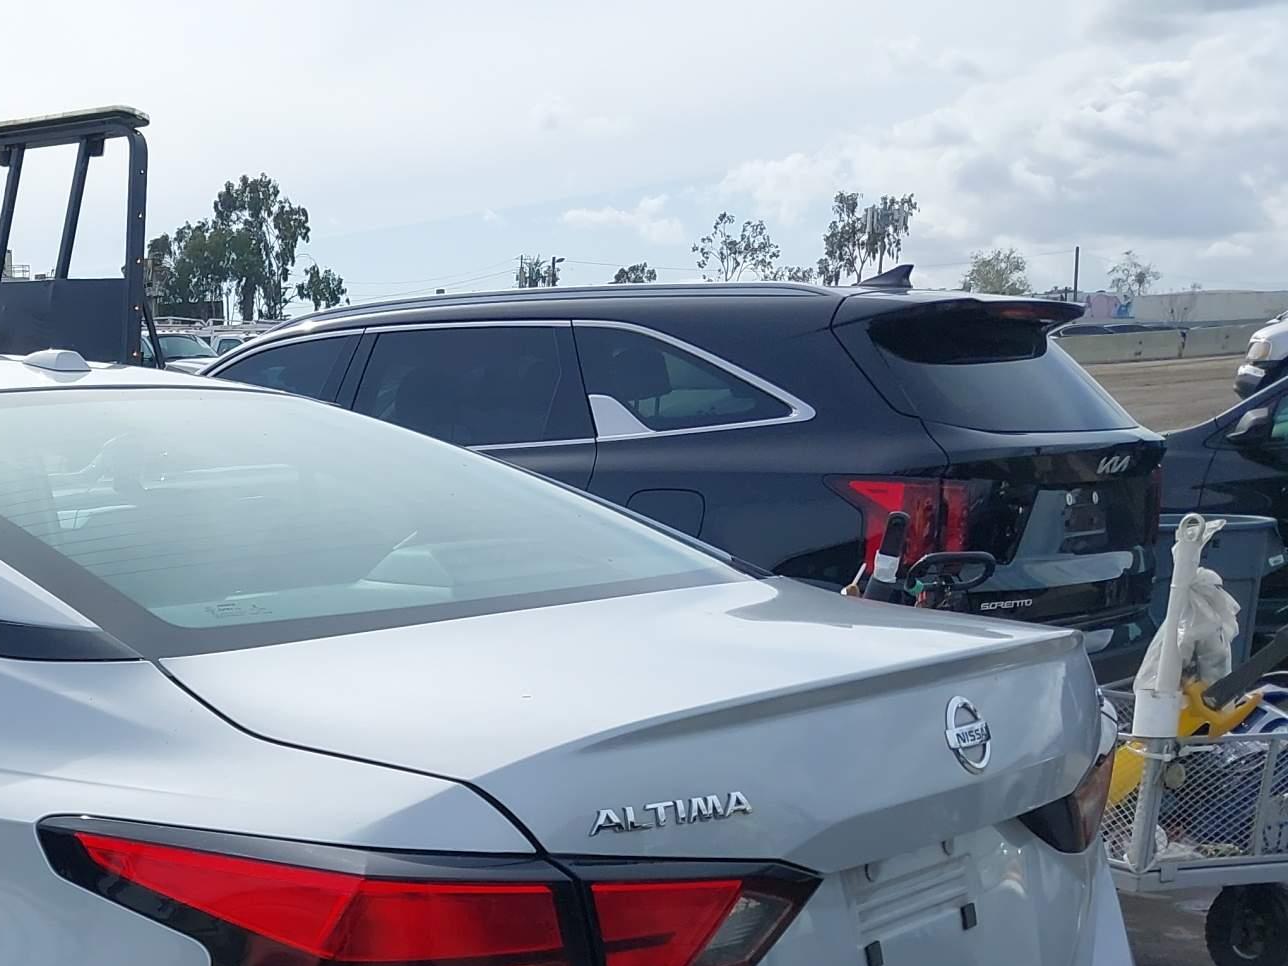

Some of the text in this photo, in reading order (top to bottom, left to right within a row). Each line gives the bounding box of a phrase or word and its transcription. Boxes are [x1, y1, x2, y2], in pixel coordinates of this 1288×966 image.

[1096, 455, 1131, 475] KIA
[980, 599, 1033, 611] SORENTO
[588, 791, 753, 837] ALTIMA
